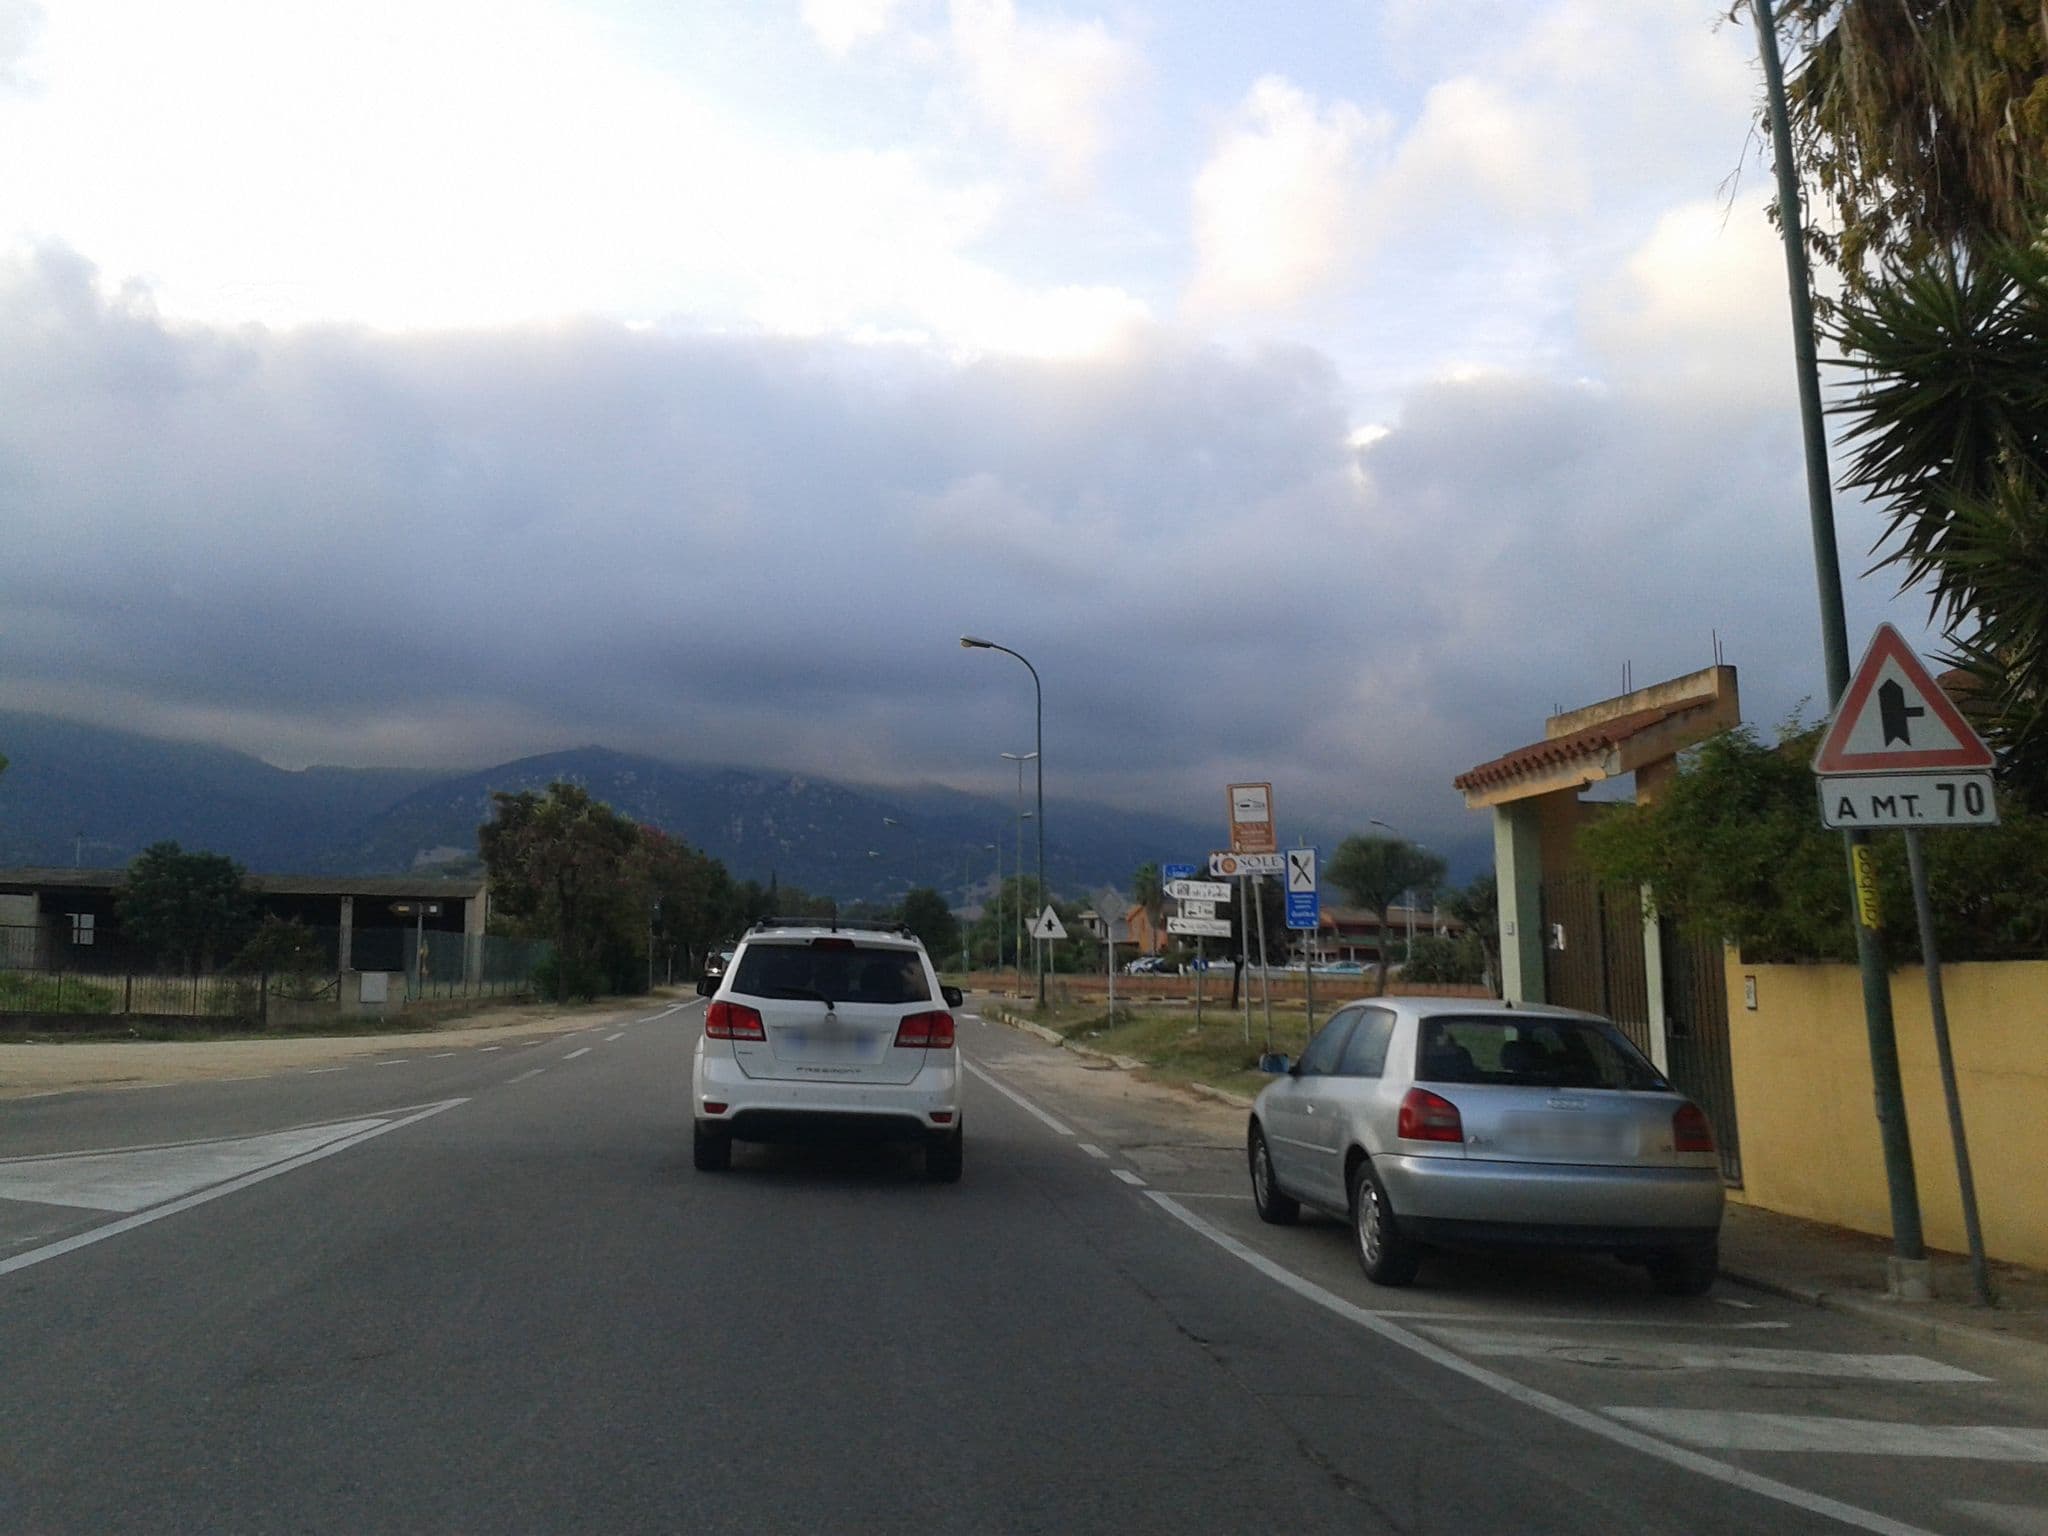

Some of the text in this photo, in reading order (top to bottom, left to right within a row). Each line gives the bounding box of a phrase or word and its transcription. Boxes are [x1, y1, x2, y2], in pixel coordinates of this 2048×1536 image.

[1838, 782, 1984, 819] A MT. 70
